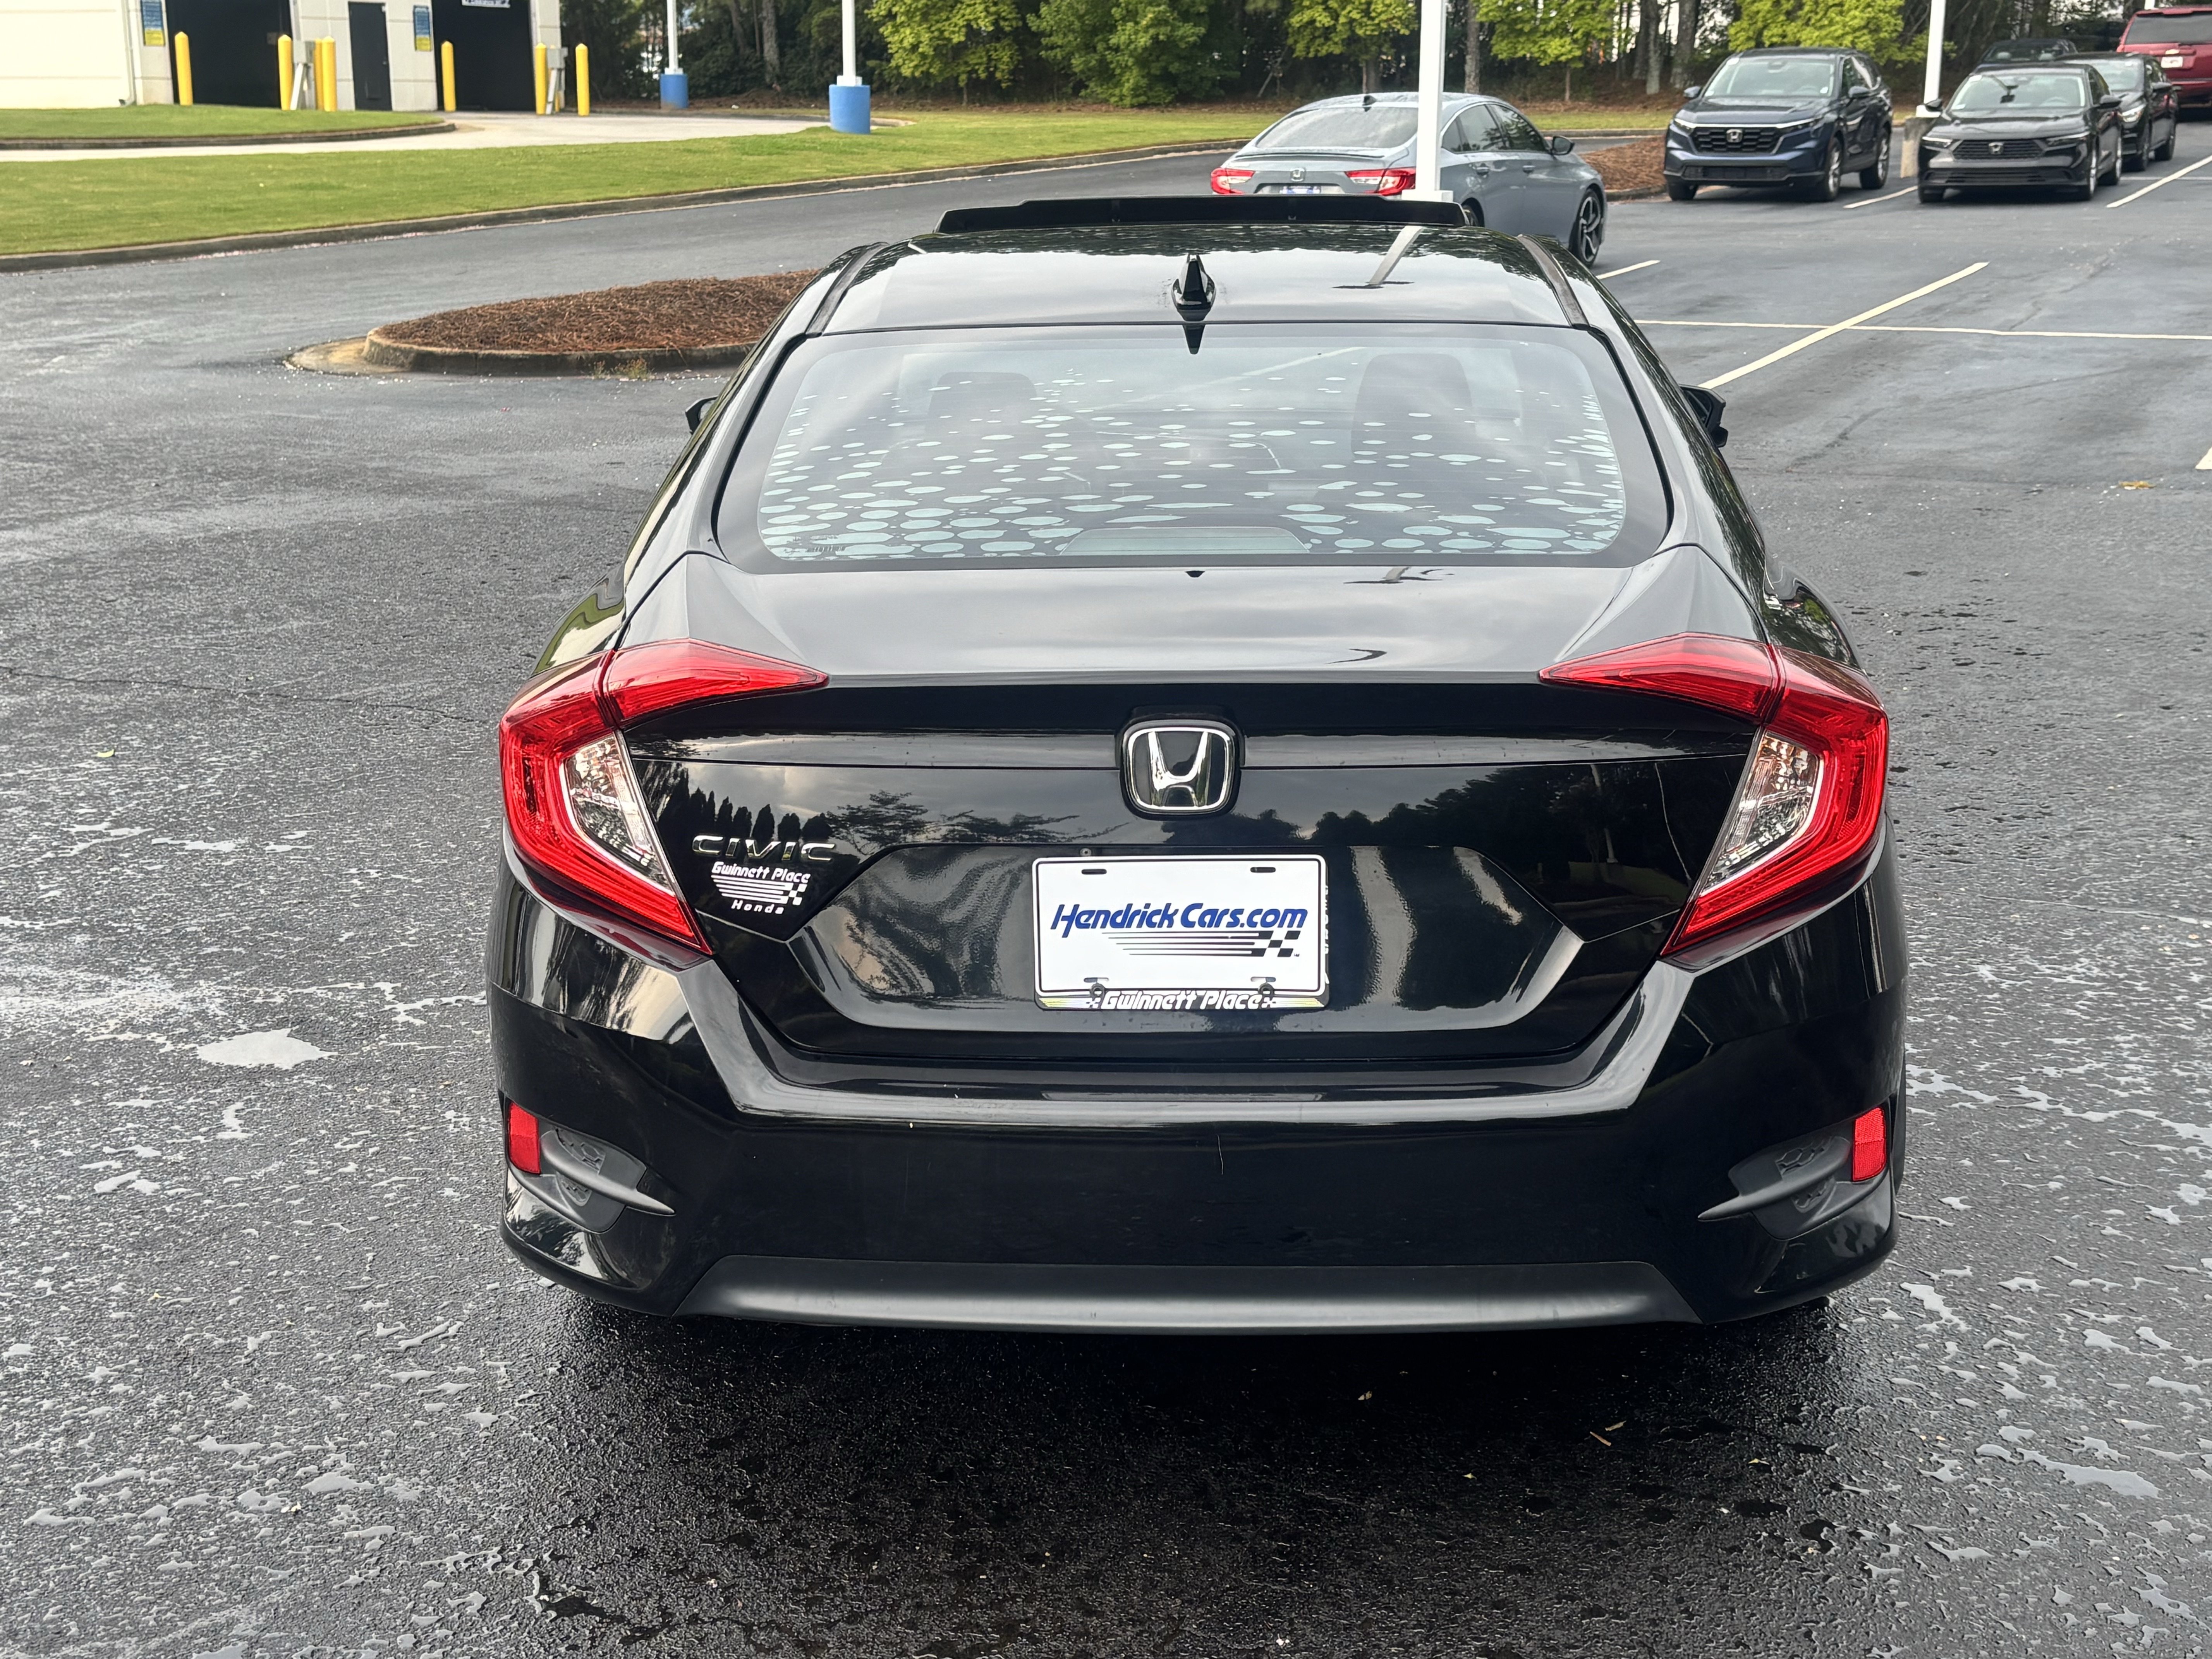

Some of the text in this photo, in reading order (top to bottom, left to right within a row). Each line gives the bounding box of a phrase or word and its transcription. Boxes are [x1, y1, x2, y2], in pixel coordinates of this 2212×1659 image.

[692, 835, 835, 861] CIVIC
[711, 861, 811, 883] Gwinnett Place
[731, 899, 784, 914] Honda
[1101, 990, 1263, 1010] Gwinnett Place
